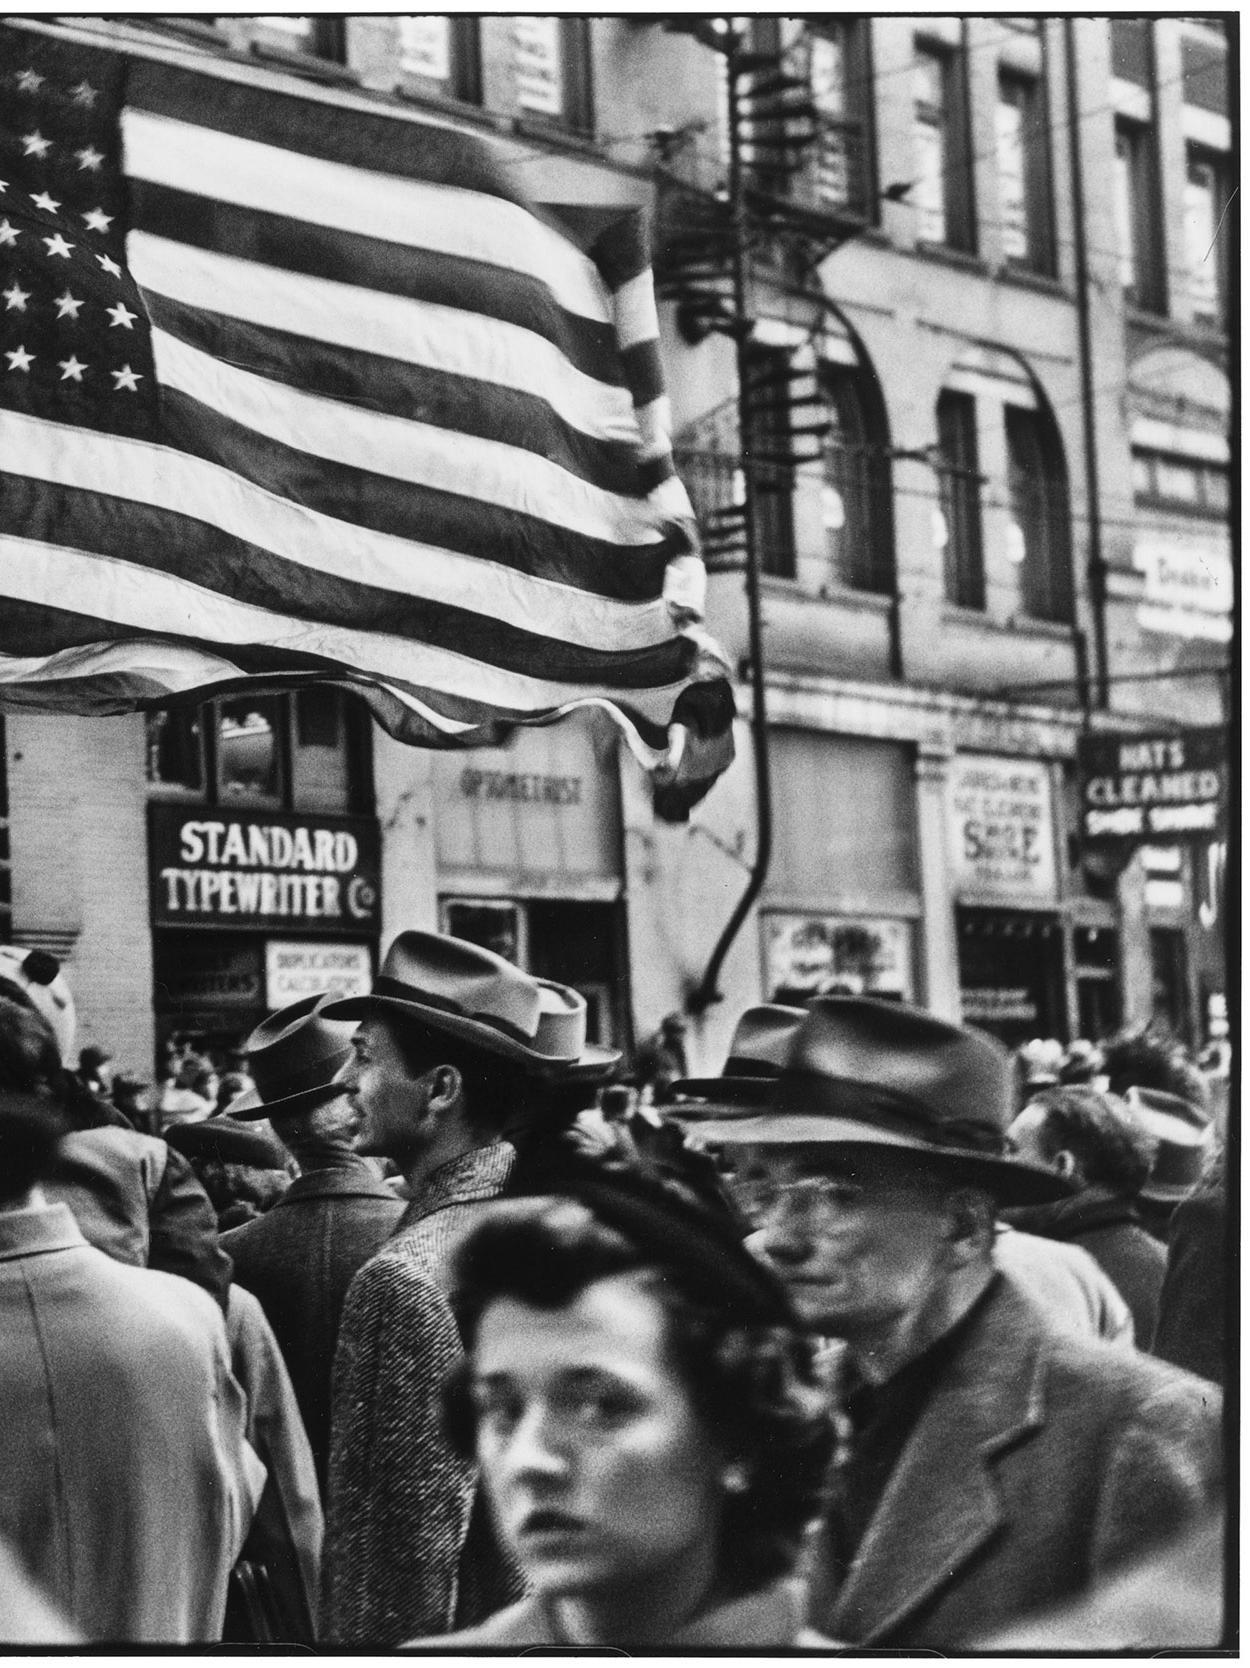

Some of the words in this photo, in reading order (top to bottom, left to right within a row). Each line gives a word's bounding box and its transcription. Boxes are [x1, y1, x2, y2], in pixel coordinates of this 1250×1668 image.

[1086, 770, 1220, 805] CLEANED
[180, 820, 358, 873] STANDARD
[161, 867, 341, 916] TYPEWRITER
